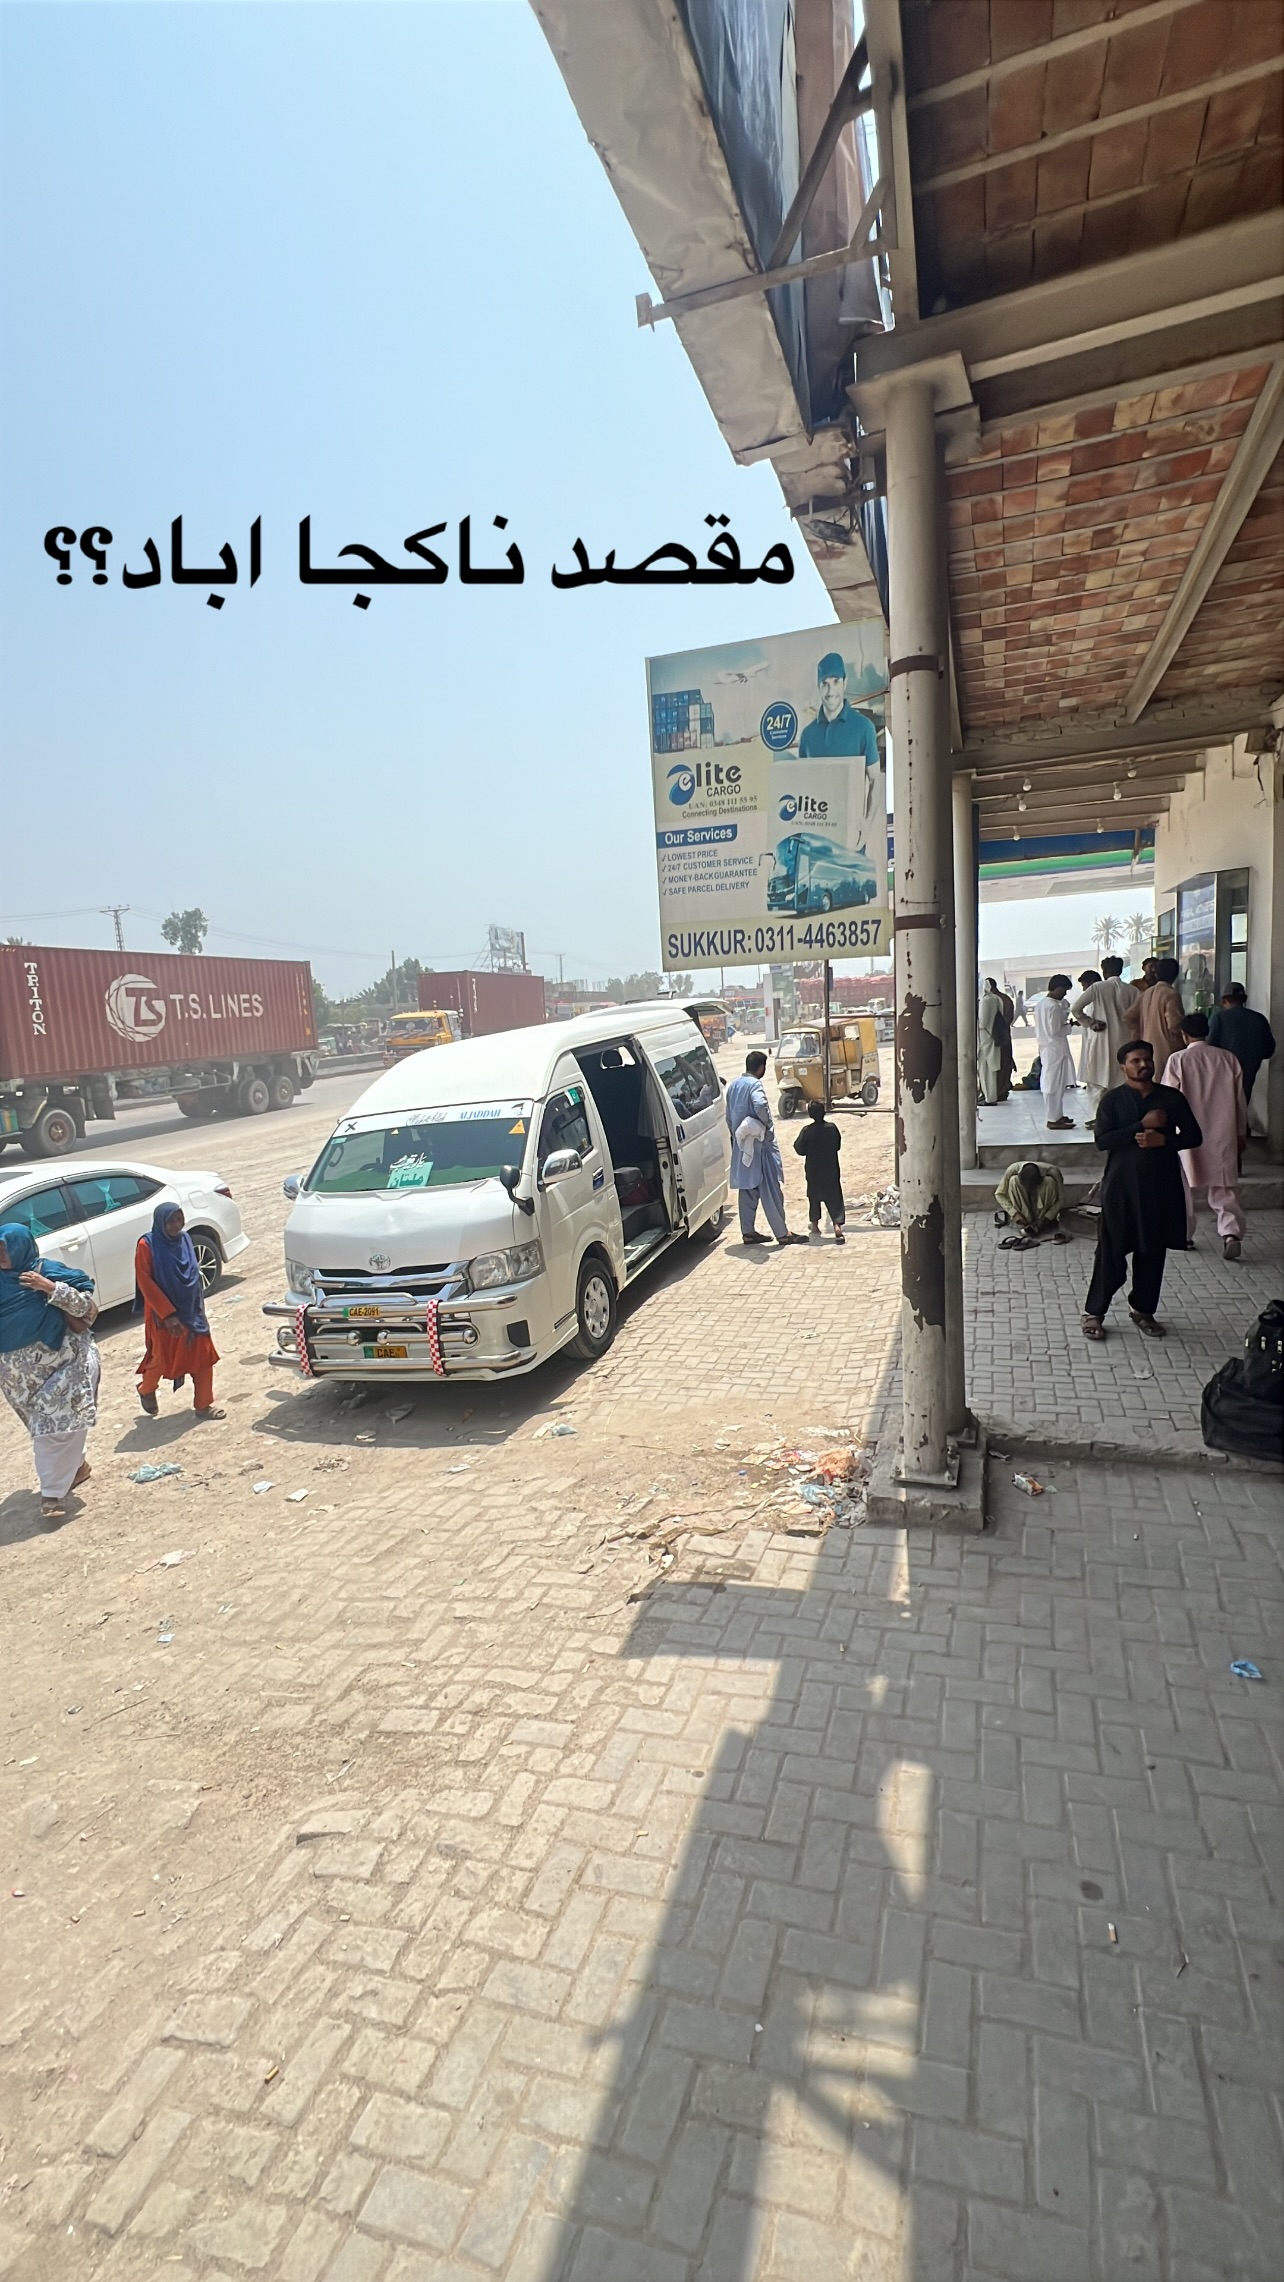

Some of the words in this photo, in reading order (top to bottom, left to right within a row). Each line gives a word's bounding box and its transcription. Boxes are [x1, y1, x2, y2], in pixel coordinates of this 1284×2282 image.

[767, 714, 792, 730] 24/7
[672, 762, 742, 794] elite
[706, 784, 742, 798] CARGO
[682, 809, 717, 819] Connecting
[718, 804, 758, 815] Destinations
[783, 795, 829, 815] elite
[803, 812, 828, 820] CARGO
[664, 832, 685, 845] Our
[687, 828, 733, 842] Services
[667, 851, 696, 862] LOWEST
[697, 849, 718, 859] PRICE
[667, 863, 681, 872] 24/7
[683, 860, 721, 870] CUSTOMER
[723, 857, 754, 867] SERVICE
[668, 885, 686, 895] SAFE
[687, 883, 716, 893] PARCEL
[715, 881, 750, 891] DELIVERY
[755, 919, 882, 953] 0311-4463857
[24, 962, 47, 1036] TRITON
[211, 993, 264, 1019] LINES
